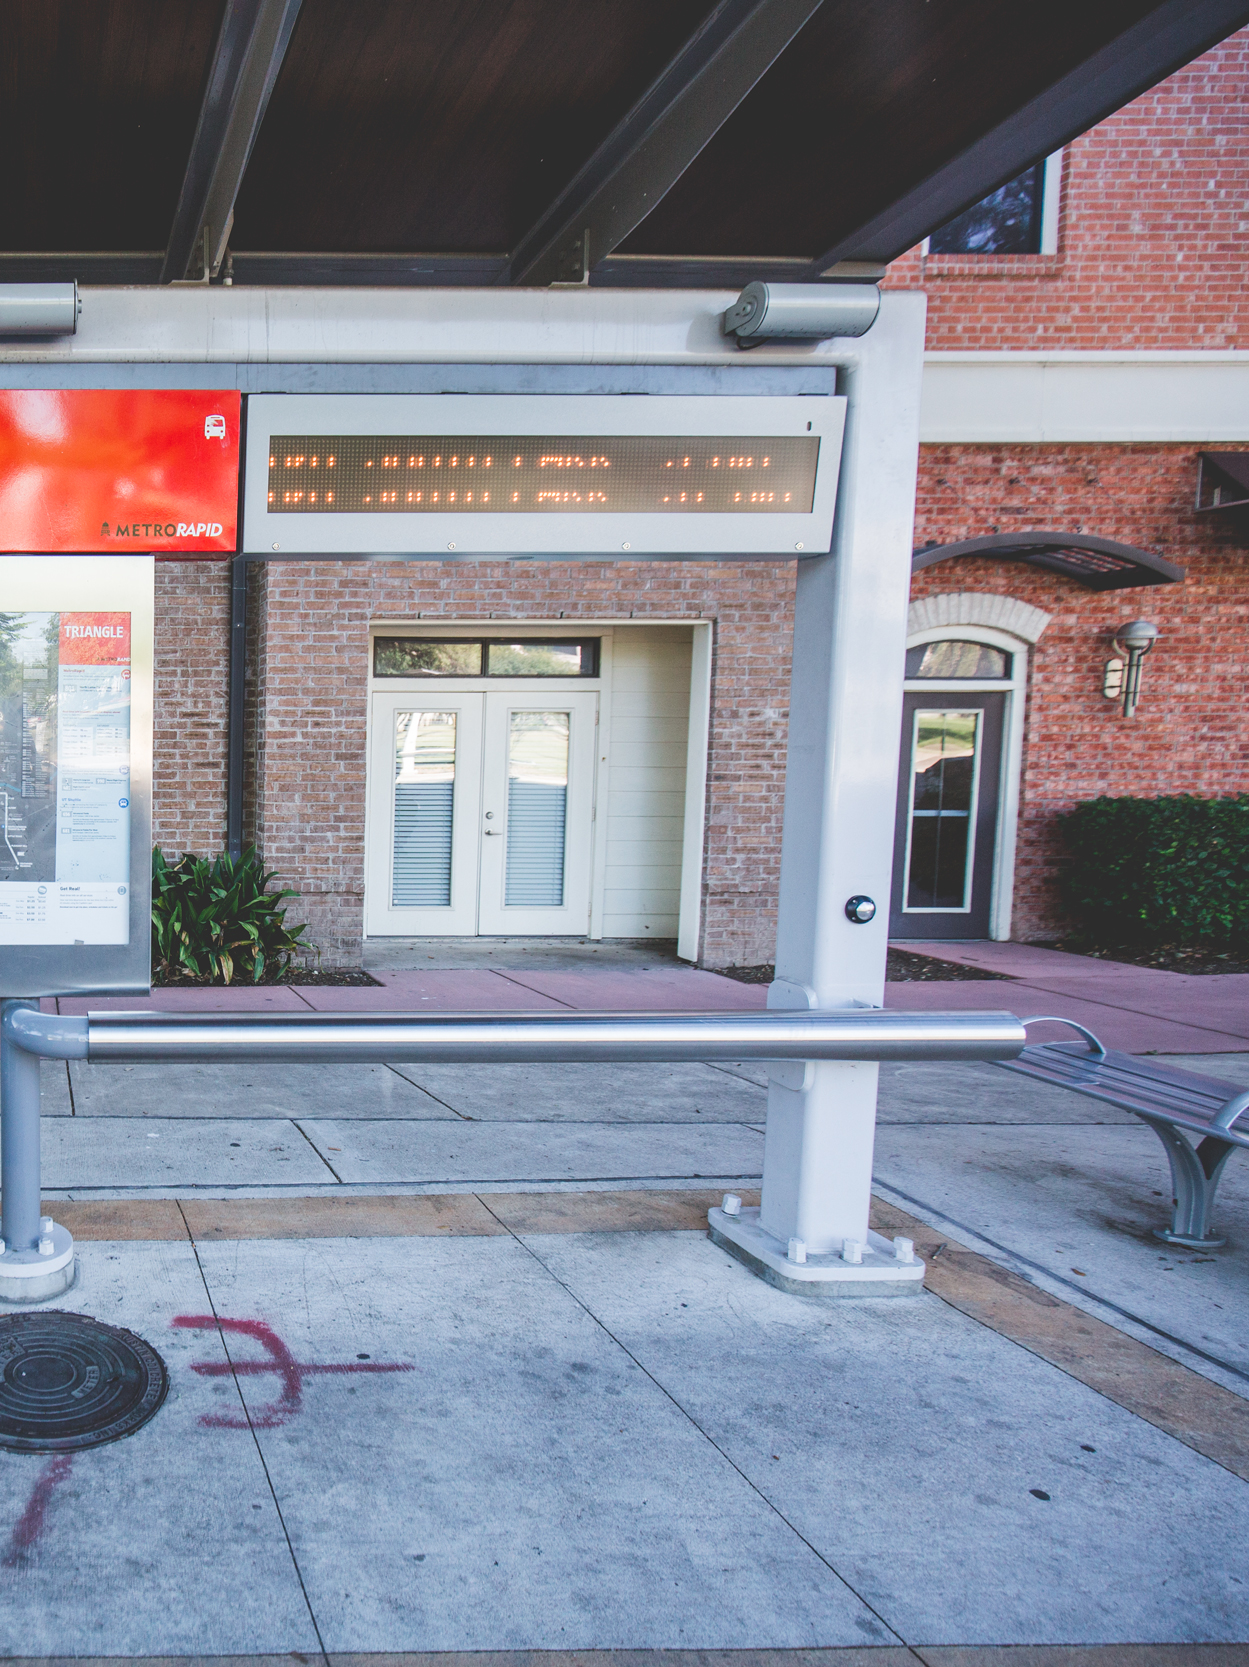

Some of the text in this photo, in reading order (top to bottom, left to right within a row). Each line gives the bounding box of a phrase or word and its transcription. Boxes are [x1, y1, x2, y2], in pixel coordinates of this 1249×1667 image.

[115, 522, 224, 537] METRORAPID
[64, 625, 124, 638] TRIANGLE
[76, 1369, 99, 1395] METER
[144, 1358, 161, 1401] CONCRETE
